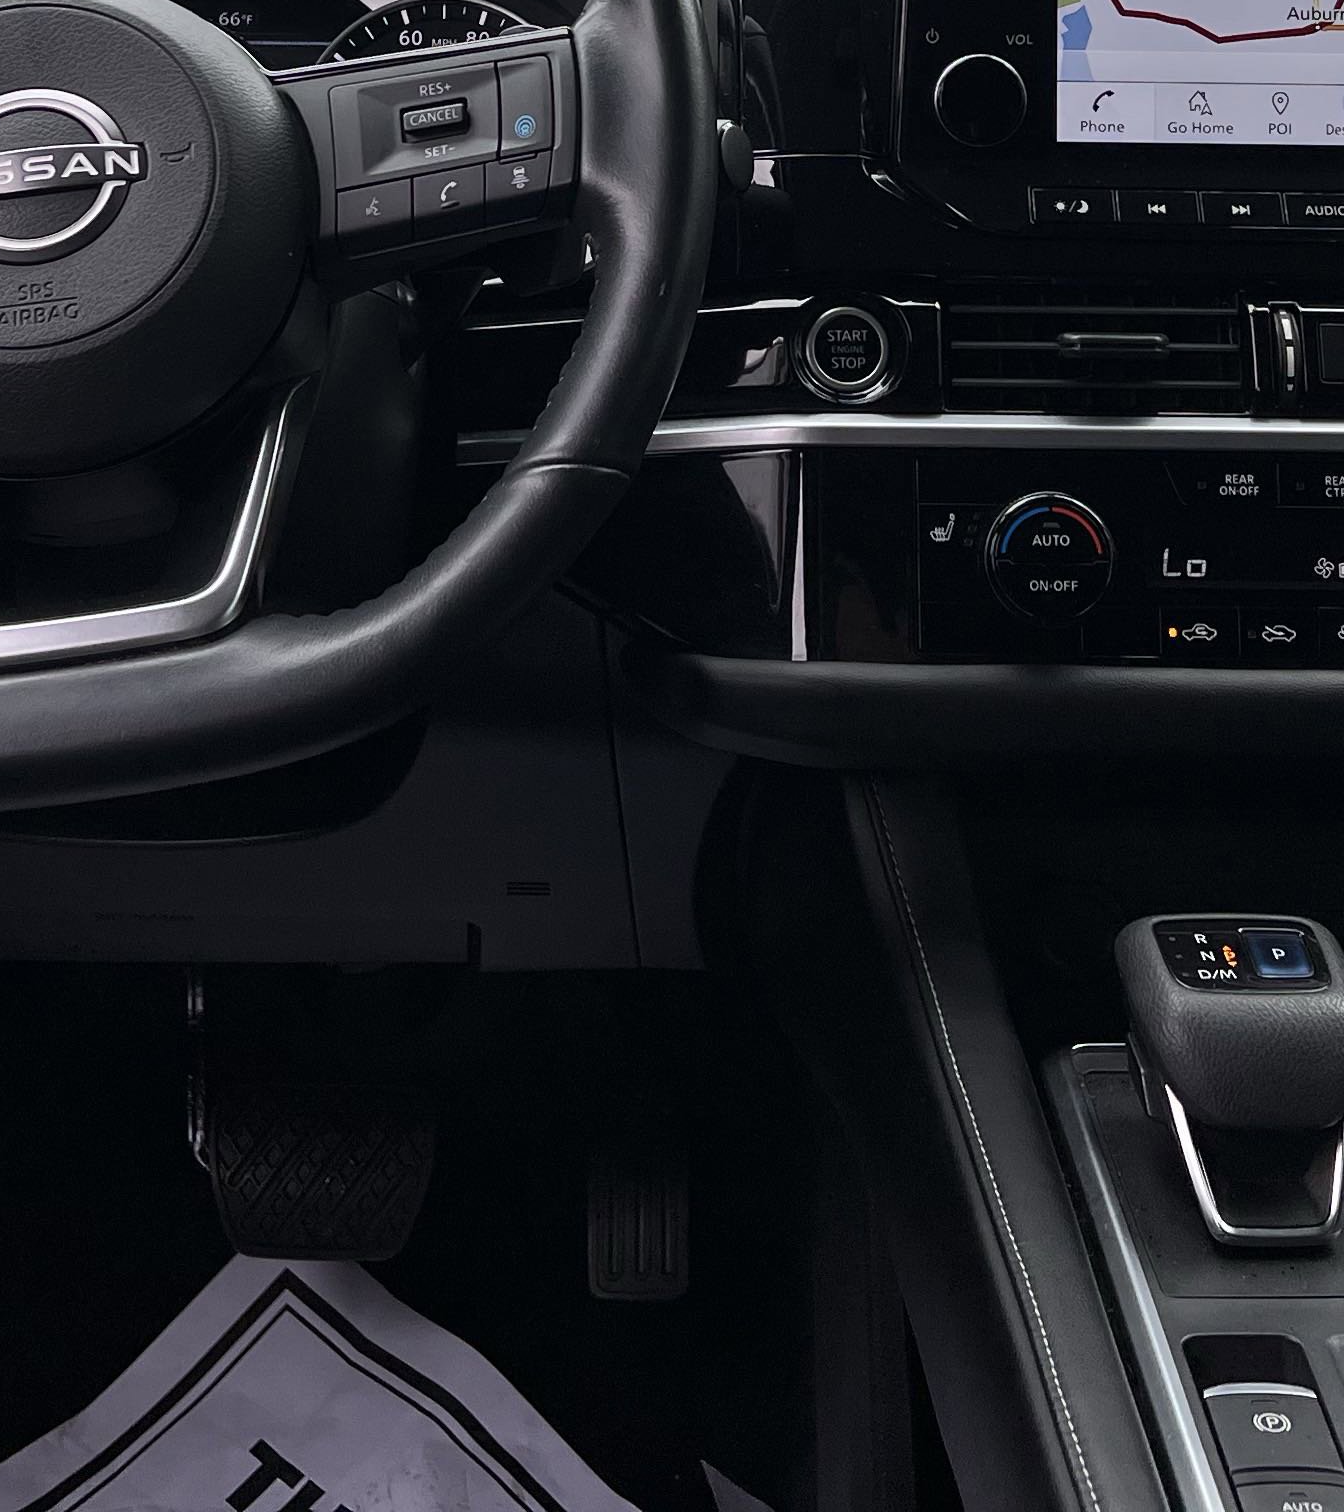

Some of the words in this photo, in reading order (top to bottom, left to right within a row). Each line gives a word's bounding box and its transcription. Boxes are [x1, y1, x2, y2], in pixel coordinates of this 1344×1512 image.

[399, 30, 423, 46] 60
[466, 31, 490, 43] 80
[1005, 34, 1034, 45] VOL
[419, 82, 452, 97] RES+
[409, 108, 459, 126] CANCEL
[1080, 120, 1125, 134] Phone
[1167, 121, 1188, 135] Go
[1192, 121, 1234, 135] Home
[1268, 123, 1292, 135] POI
[16, 282, 55, 301] SRS
[826, 329, 869, 343] START
[831, 345, 865, 354] ENGINE
[831, 356, 867, 369] STOP
[1224, 474, 1255, 485] REAR
[1032, 534, 1071, 547] AUTO
[1193, 933, 1207, 945] R
[1199, 950, 1216, 962] N
[1271, 947, 1286, 961] P
[1197, 969, 1238, 980] D/M
[1282, 1501, 1323, 1512] AUTO
